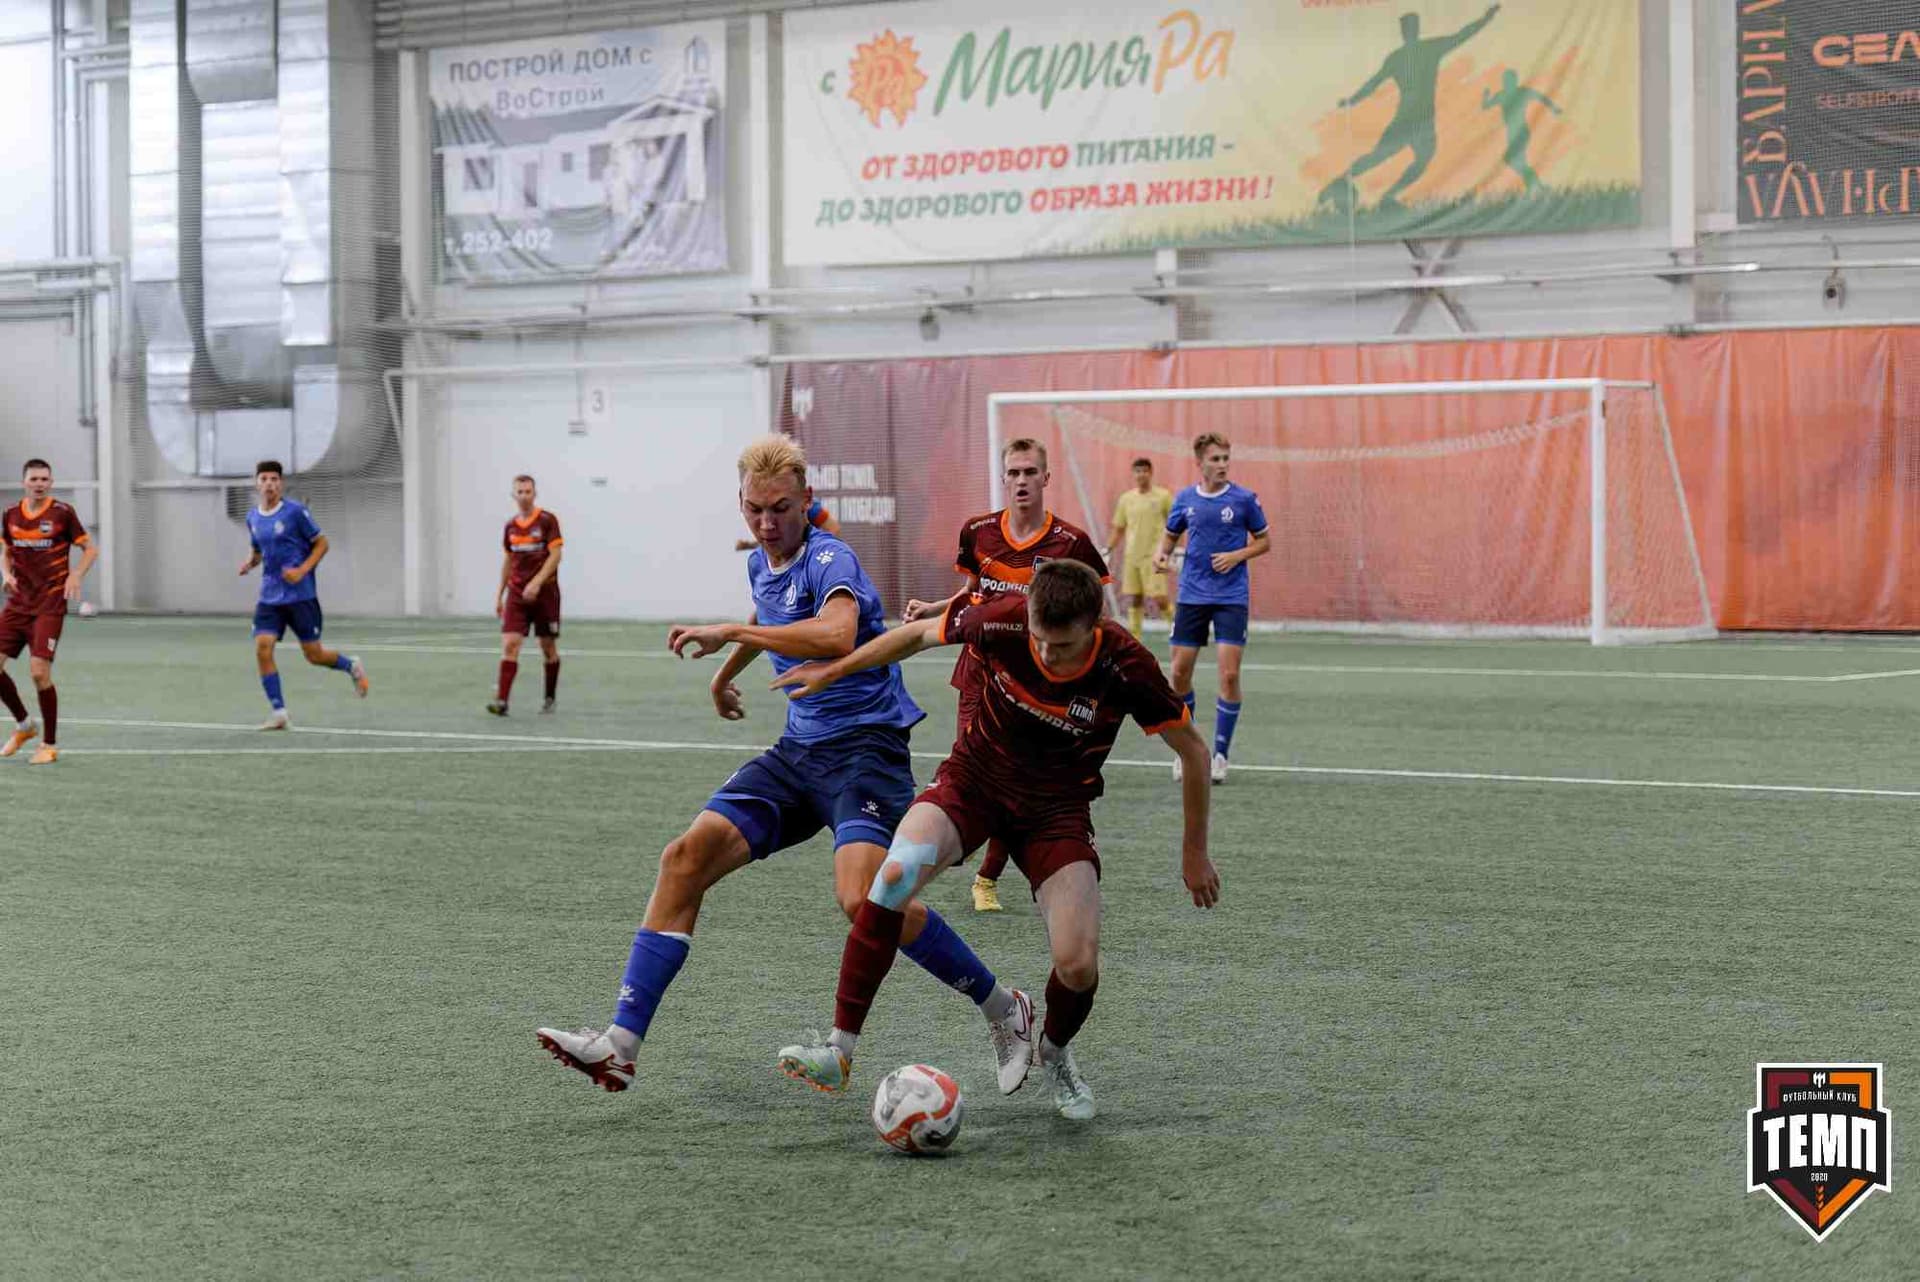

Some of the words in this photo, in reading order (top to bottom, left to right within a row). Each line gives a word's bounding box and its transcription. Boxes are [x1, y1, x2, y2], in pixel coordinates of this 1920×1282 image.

[450, 49, 565, 82] ПОСТРОЙ
[573, 46, 632, 75] ДОМ
[819, 71, 836, 94] с
[861, 154, 898, 181] ОТ
[902, 143, 1070, 182] ЗДОРОВОГО
[1076, 133, 1217, 167] ПИТАНИЯ
[815, 198, 856, 228] ДО
[859, 189, 1024, 226] ЗДОРОВОГО
[1029, 182, 1138, 213] ОБРАЗА
[591, 389, 604, 413] 3
[1071, 703, 1094, 723] ТЕМП
